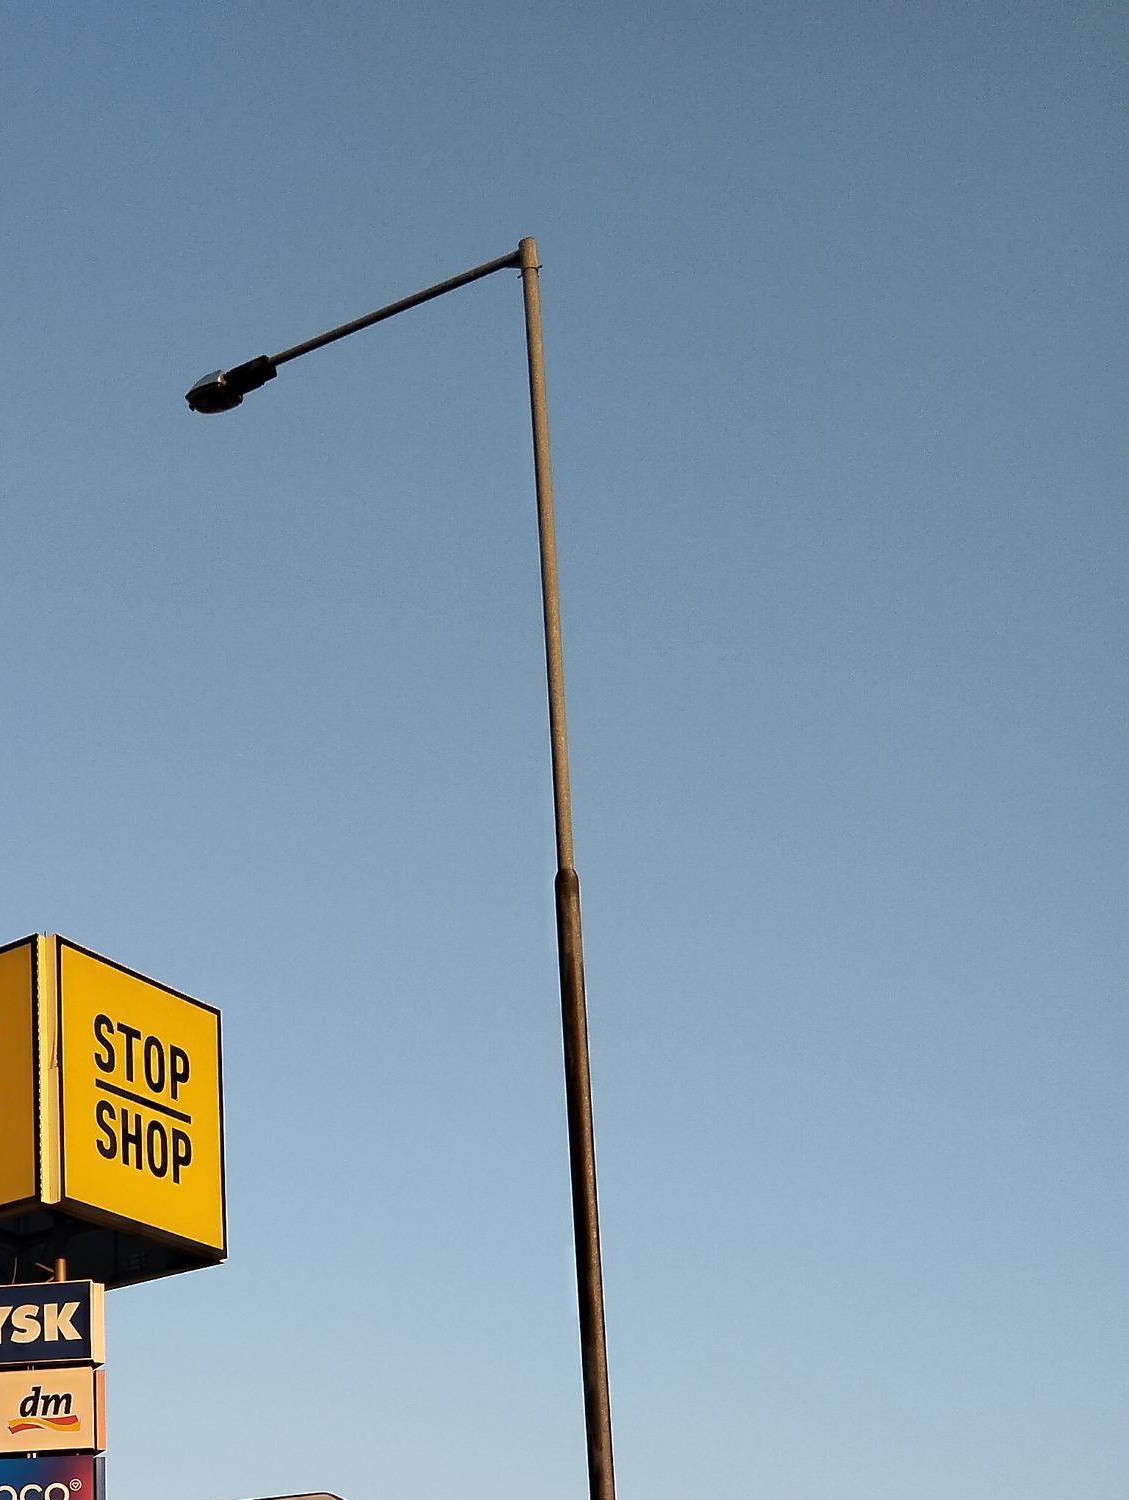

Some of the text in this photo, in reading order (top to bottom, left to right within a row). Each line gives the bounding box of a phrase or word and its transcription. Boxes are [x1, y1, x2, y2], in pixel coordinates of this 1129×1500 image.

[93, 1013, 191, 1102] STOP
[95, 1100, 192, 1184] SHOP
[20, 1386, 73, 1418] dm
